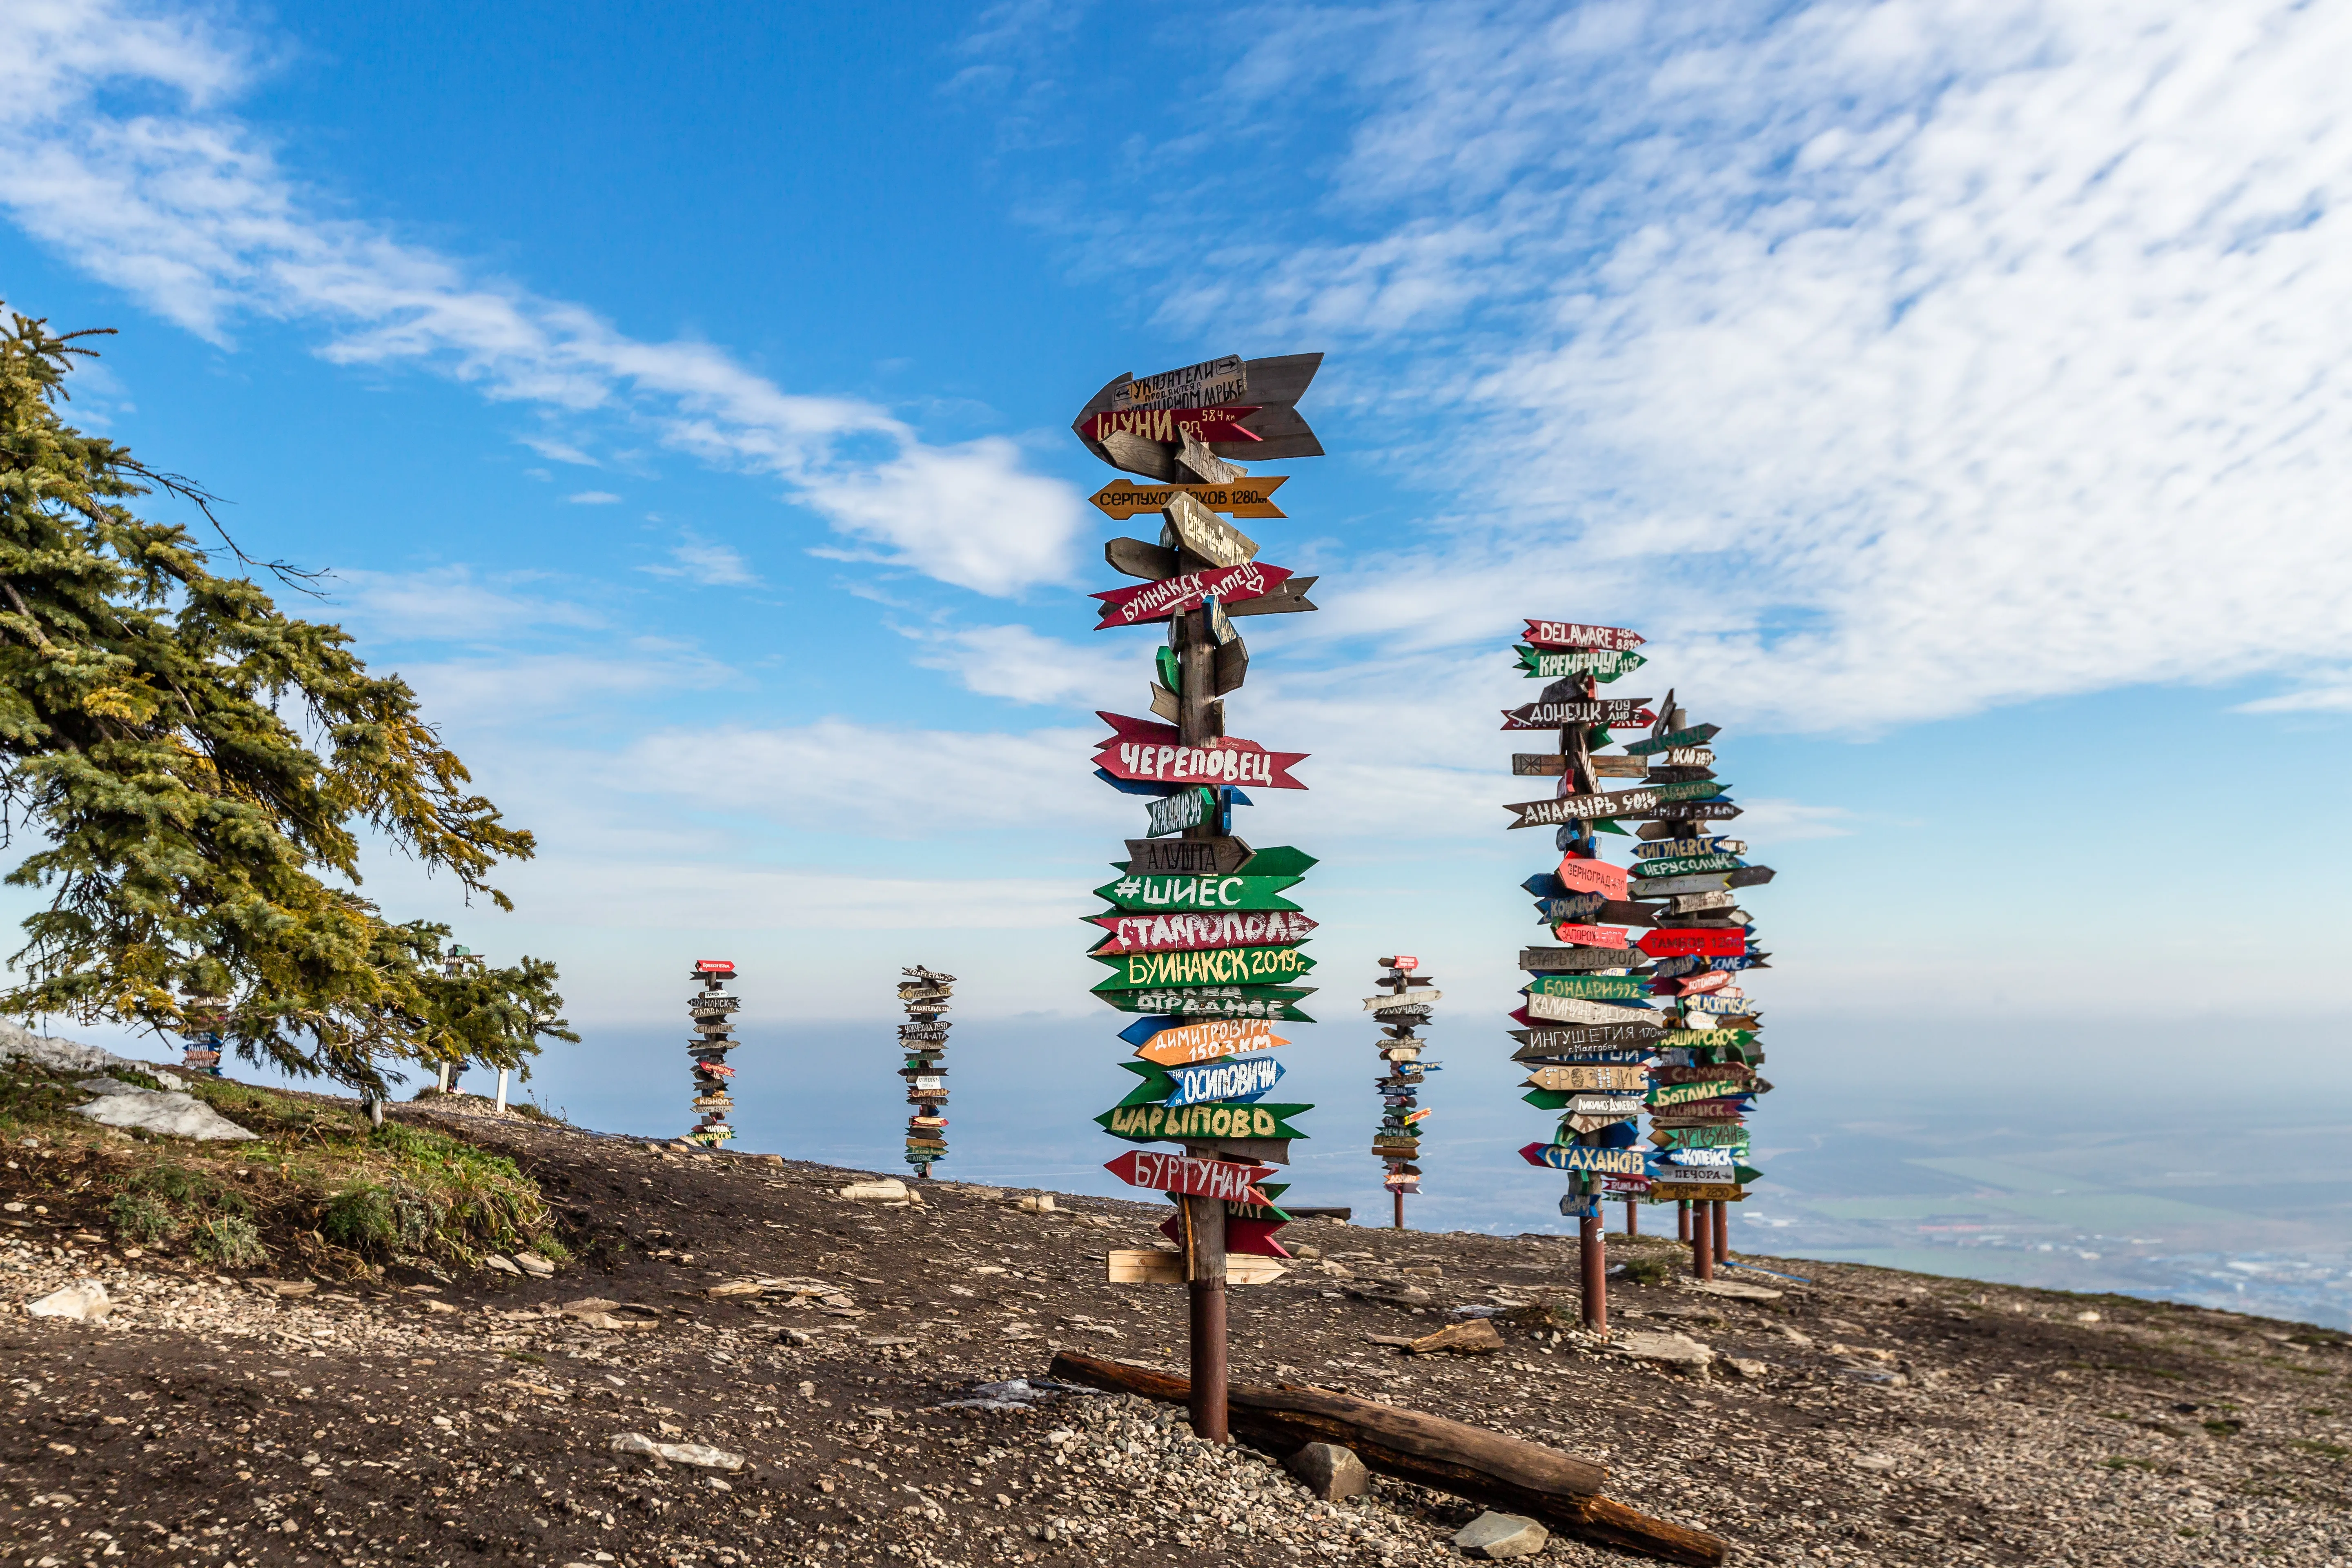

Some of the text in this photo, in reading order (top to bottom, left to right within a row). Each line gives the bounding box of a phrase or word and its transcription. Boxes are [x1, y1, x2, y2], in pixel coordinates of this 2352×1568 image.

[1132, 361, 1214, 399] УКАЗАТЕЛИ
[1145, 383, 1194, 403] ПРОДАЮТСЯ
[1202, 409, 1223, 422] 584
[1121, 572, 1203, 622] БУЙНАКСК
[1541, 622, 1613, 649] DELAWARE
[1617, 628, 1635, 639] USA
[1539, 650, 1640, 677] КРЕМЕНЧУГ 1147
[1530, 702, 1601, 722] ДОНЕЦК
[1607, 700, 1630, 711] 709
[1120, 742, 1273, 787] ЧЕРЕПОВЕЦ
[1673, 748, 1695, 764] ОСЛО
[1152, 793, 1189, 834] КРАСНОДАР
[1524, 796, 1617, 824] АНАДЫРЬ
[1147, 843, 1217, 871] АЛУШТА
[1637, 837, 1715, 858] ЖИГУЛЕВСК
[1567, 862, 1610, 890] ЗЕРНОГРАД
[1114, 876, 1244, 906] #ШИЕС
[1117, 912, 1311, 950] СТАВРОПОЛЬ
[1650, 937, 1705, 949] ТАМБОВ
[1587, 951, 1637, 967] ОСКОЛ
[690, 999, 729, 1008] МУРМАНСК
[694, 1007, 724, 1016] МАГАДАН
[904, 1022, 948, 1033] ЧОКУРДАХ 7850
[905, 1032, 947, 1040] АЛМА-АТА
[1530, 1026, 1634, 1048] ИНГУШЕТИЯ
[1188, 1034, 1272, 1062] 1503 КМ
[1184, 1060, 1277, 1104] ОСИПОВИЧИ
[1545, 1067, 1633, 1089] ГРОЗНЫЙ
[1111, 1104, 1276, 1138] ШАРЫПОВО
[1382, 1127, 1412, 1137] ЧЕЧНЯ
[695, 1131, 731, 1141] ЧЕРКАССЫ
[1545, 1146, 1645, 1175] СТАХАНОВ
[1682, 1148, 1733, 1166] КОПЕЙСК
[1135, 1152, 1251, 1203] БУРТУНАЙ
[1675, 1169, 1722, 1180] ПЕЧОРА
